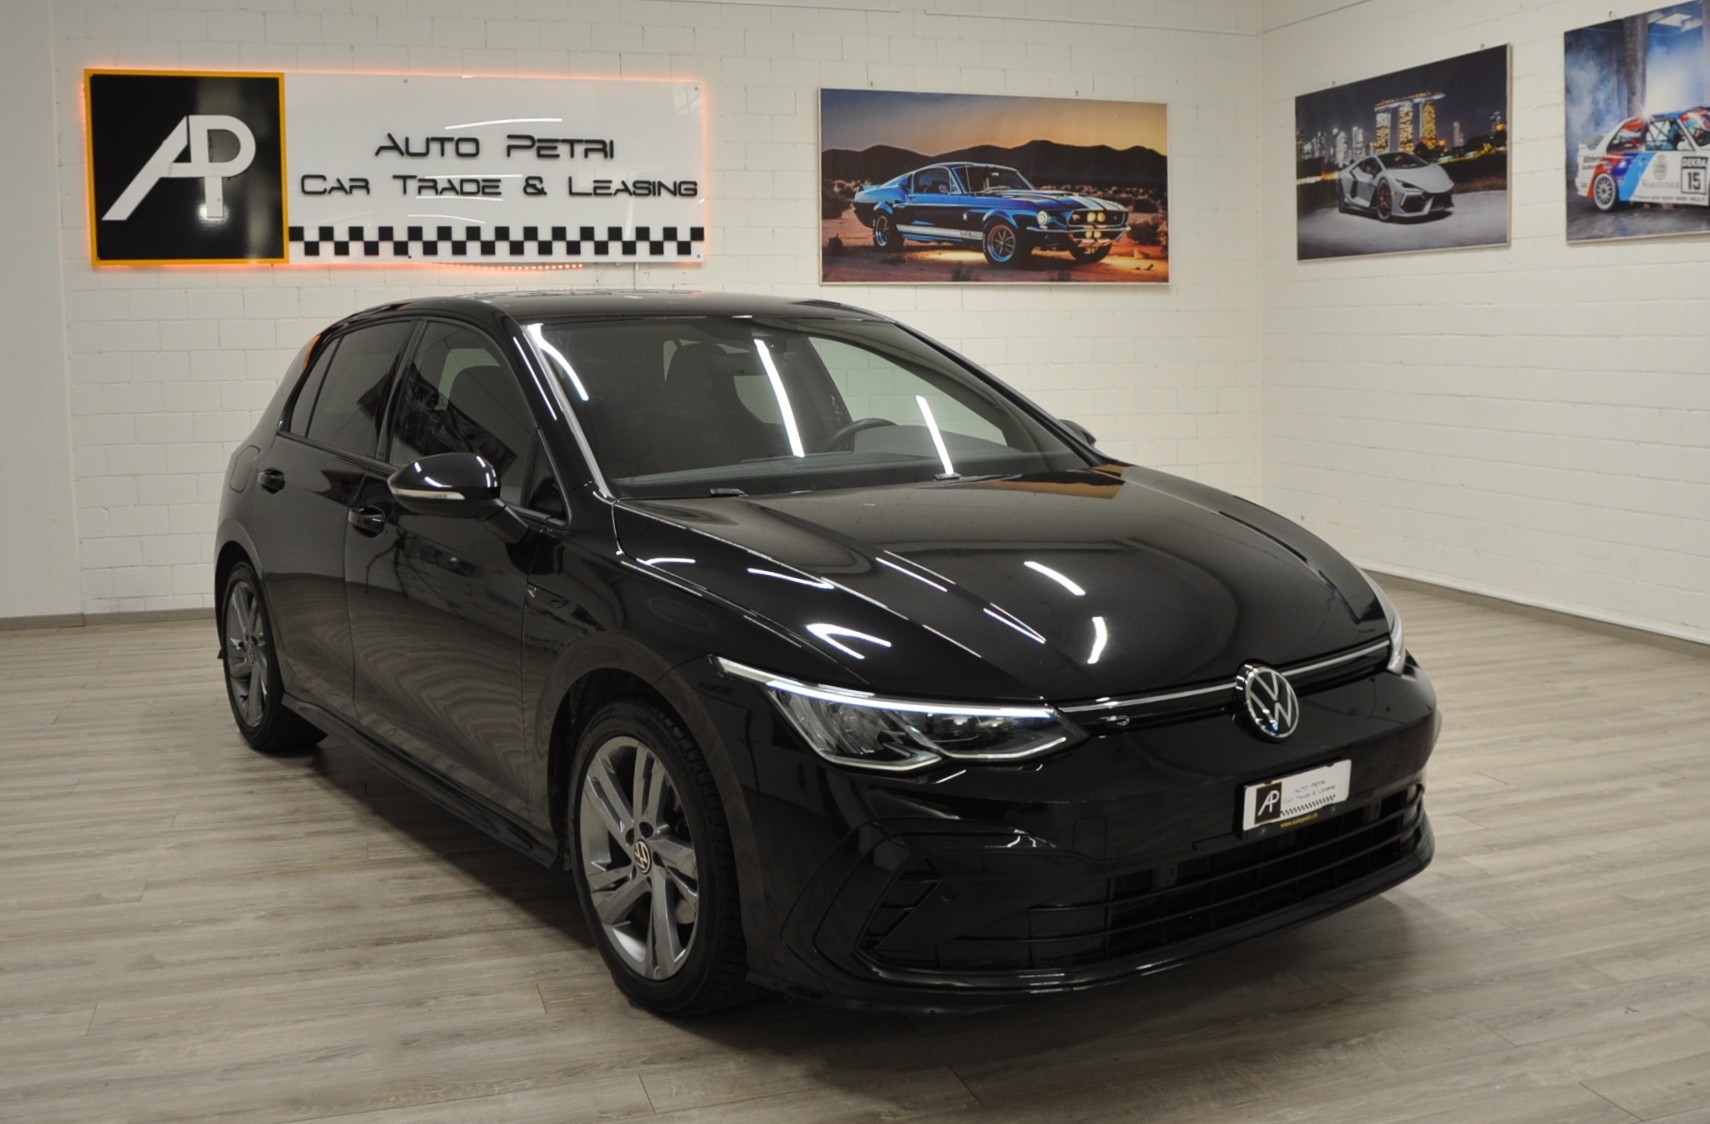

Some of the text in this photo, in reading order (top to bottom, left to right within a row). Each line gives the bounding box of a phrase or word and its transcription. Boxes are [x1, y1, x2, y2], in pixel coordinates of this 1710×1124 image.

[374, 132, 614, 159] AUTO PETRI
[101, 114, 257, 222] AP
[1682, 157, 1707, 168] DEKRA
[300, 174, 698, 197] CAR TRADE & LEASING
[1687, 171, 1701, 191] 15
[1257, 790, 1280, 817] AP
